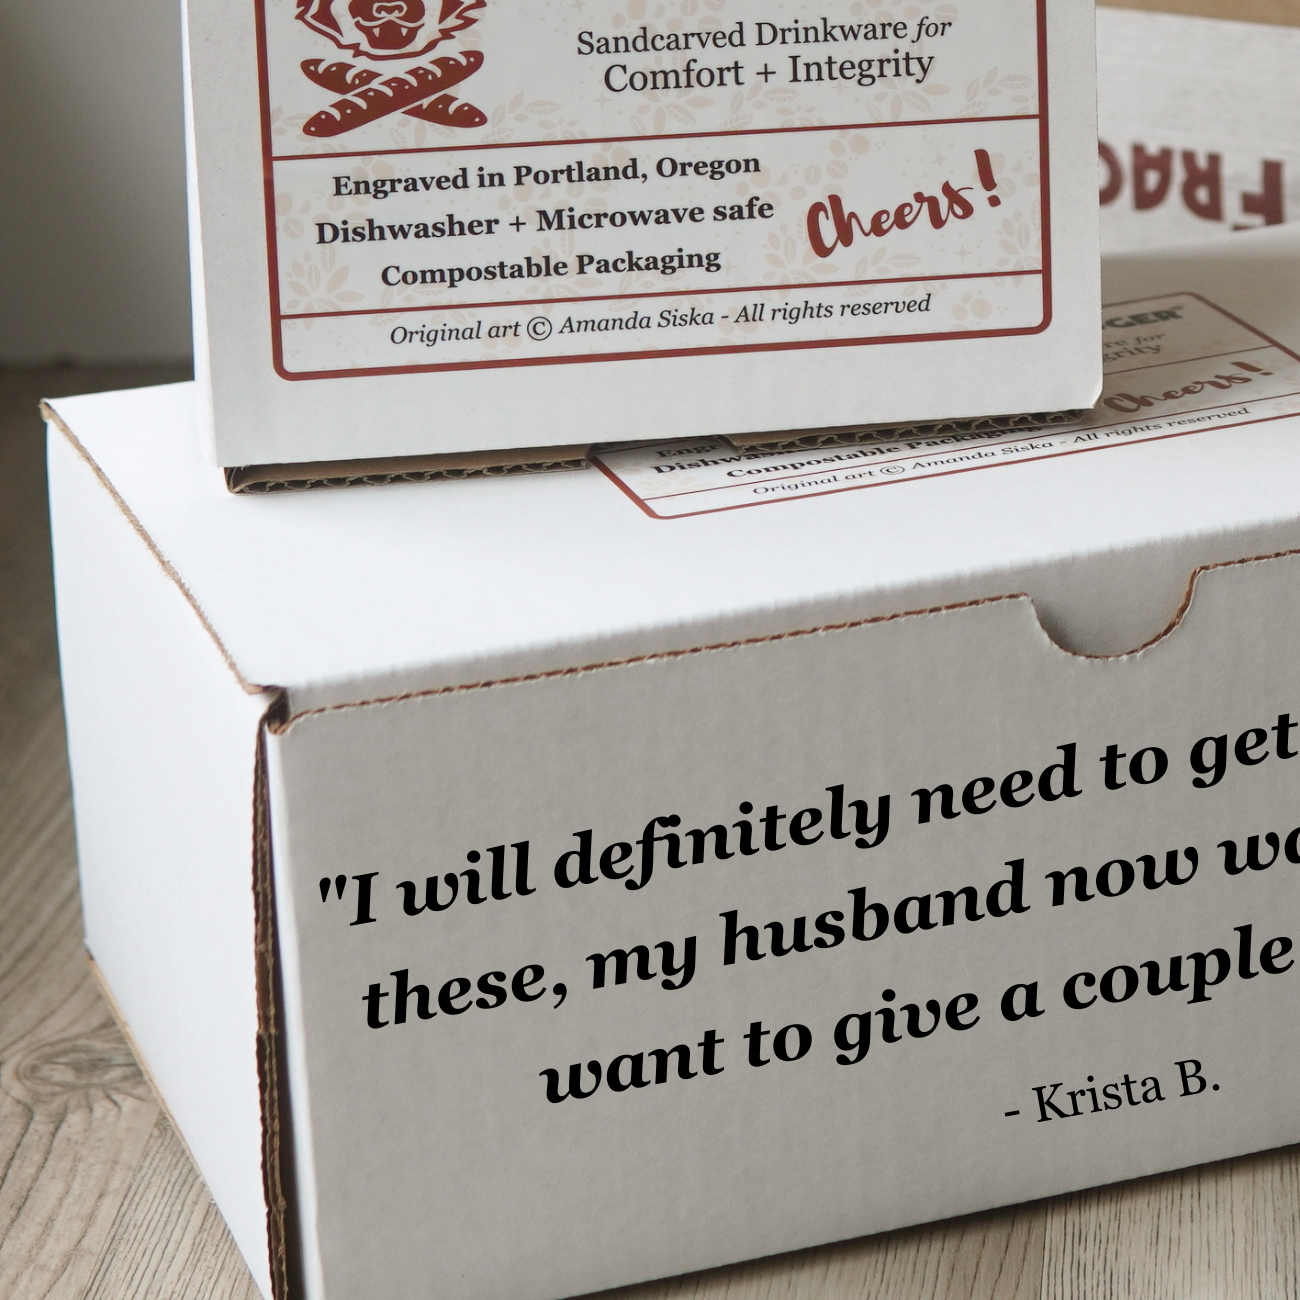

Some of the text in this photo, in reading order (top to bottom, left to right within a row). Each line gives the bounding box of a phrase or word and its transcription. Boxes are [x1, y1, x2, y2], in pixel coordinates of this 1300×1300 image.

[577, 15, 953, 56] Sandcarved Drinkware for
[604, 48, 935, 93] Comfort + Integrity
[332, 157, 761, 200] Engraved in Portland, Oregon
[315, 195, 774, 245] Dishwasher + Microwave safe
[806, 149, 1002, 258] Cheers!
[381, 247, 722, 289] Compostable Packaging
[390, 320, 482, 347] Original
[487, 321, 522, 339] art
[558, 310, 651, 334] Amanda
[657, 307, 714, 328] Siska
[733, 302, 765, 324] All
[771, 300, 834, 325] rights
[840, 292, 932, 317] reserved
[1102, 361, 1273, 414] Cheers!
[727, 443, 901, 478] Compostable
[753, 476, 841, 496] Original
[844, 469, 876, 480] art
[911, 451, 998, 470] Amanda
[1001, 440, 1054, 455] Siska
[1073, 433, 1100, 444] All
[1103, 422, 1164, 440] rights
[1166, 408, 1251, 428] reserved
